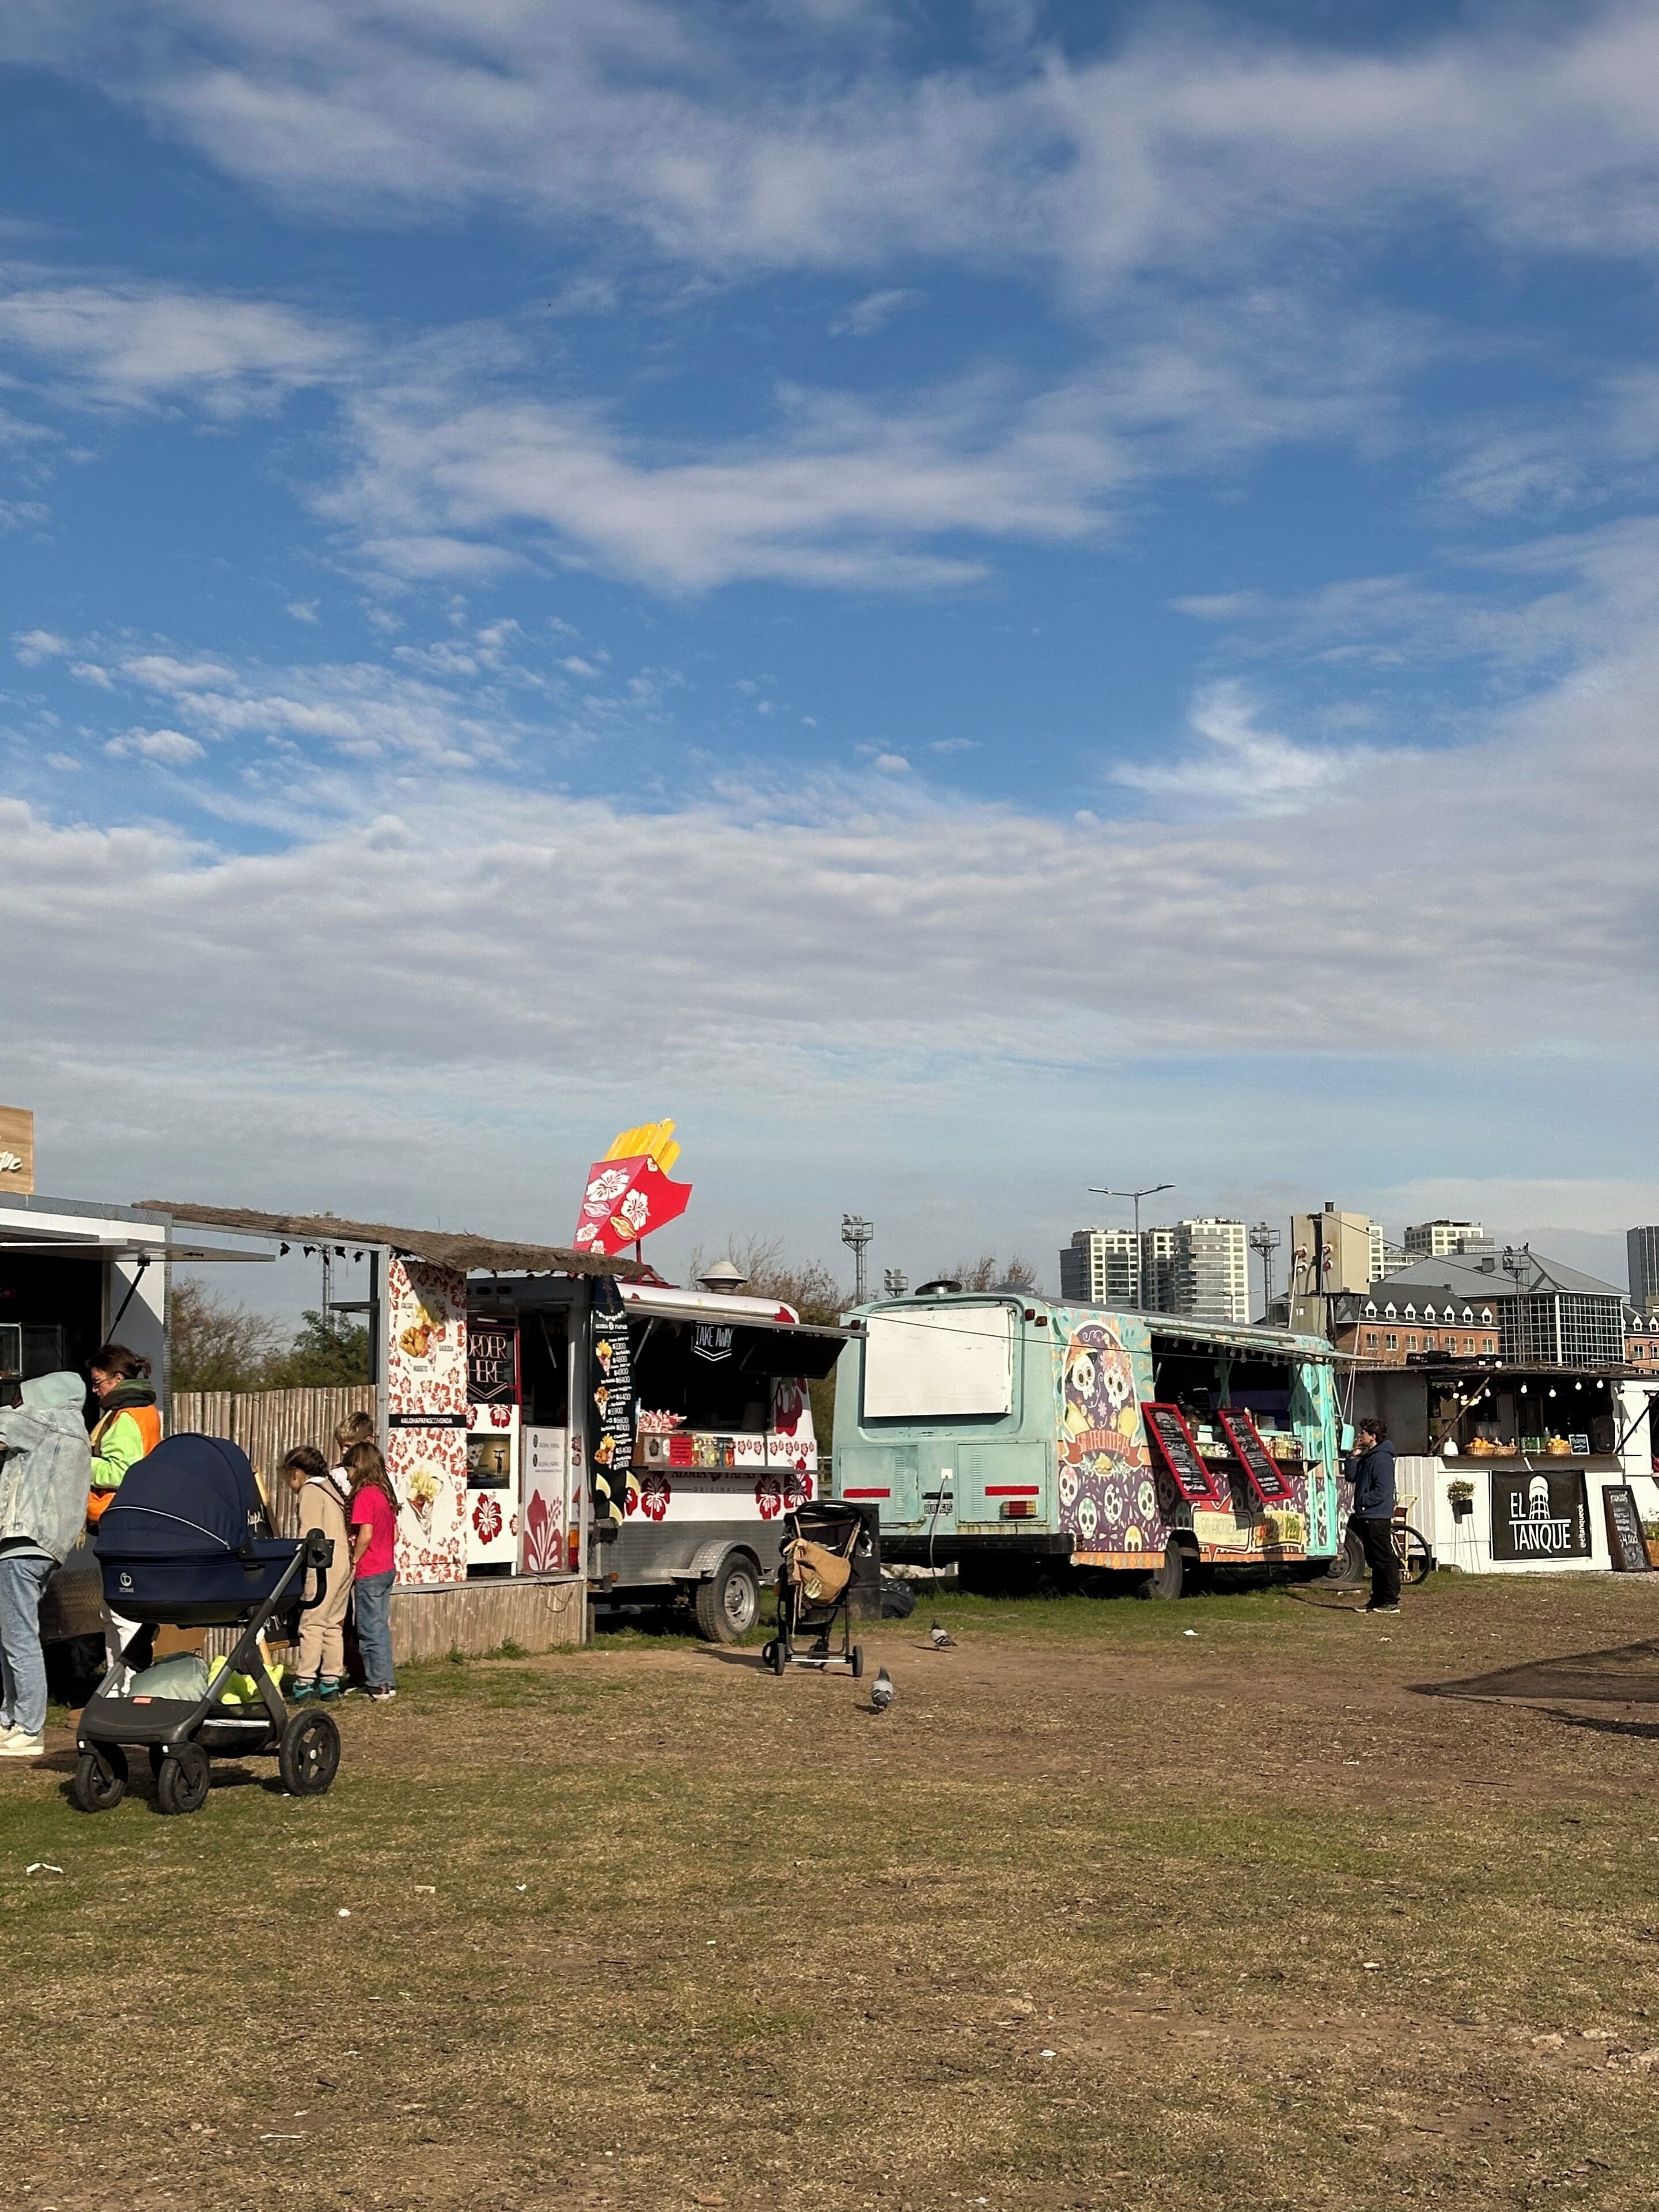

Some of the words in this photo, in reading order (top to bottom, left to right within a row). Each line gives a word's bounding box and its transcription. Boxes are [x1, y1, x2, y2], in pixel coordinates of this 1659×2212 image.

[467, 1334, 506, 1359] ORDER
[695, 1325, 714, 1347] TAKE
[715, 1328, 733, 1347] AWAY
[468, 1359, 504, 1383] HERE
[1510, 1493, 1526, 1518] EL
[1513, 1523, 1571, 1554] TANQUE
